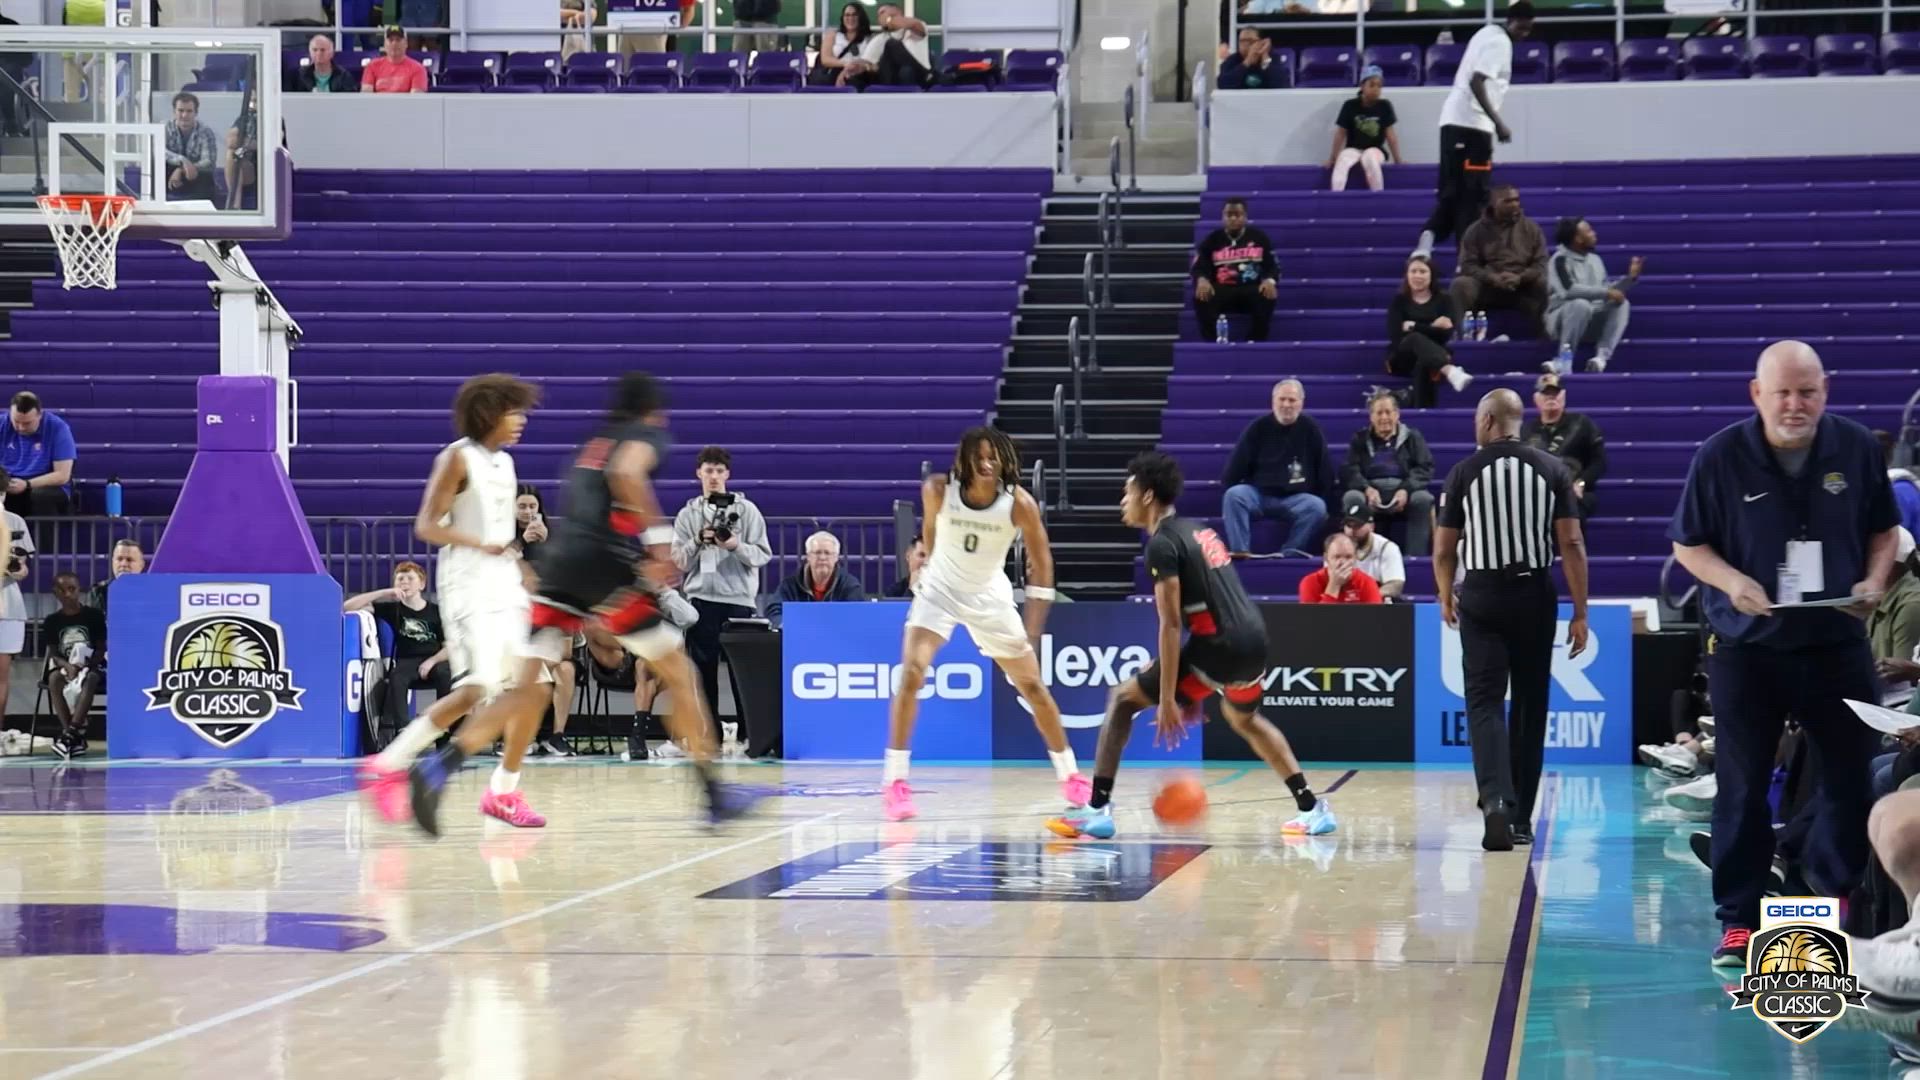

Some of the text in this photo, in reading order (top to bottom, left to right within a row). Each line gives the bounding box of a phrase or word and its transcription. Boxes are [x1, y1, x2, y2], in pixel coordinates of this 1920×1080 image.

[964, 532, 978, 553] 0
[188, 593, 260, 607] GEICO
[165, 669, 284, 691] CITY OF PALMS
[791, 663, 984, 700] GEICO
[184, 693, 260, 716] CLASSIC
[1262, 696, 1395, 707] ELEVATE YOUR GAME
